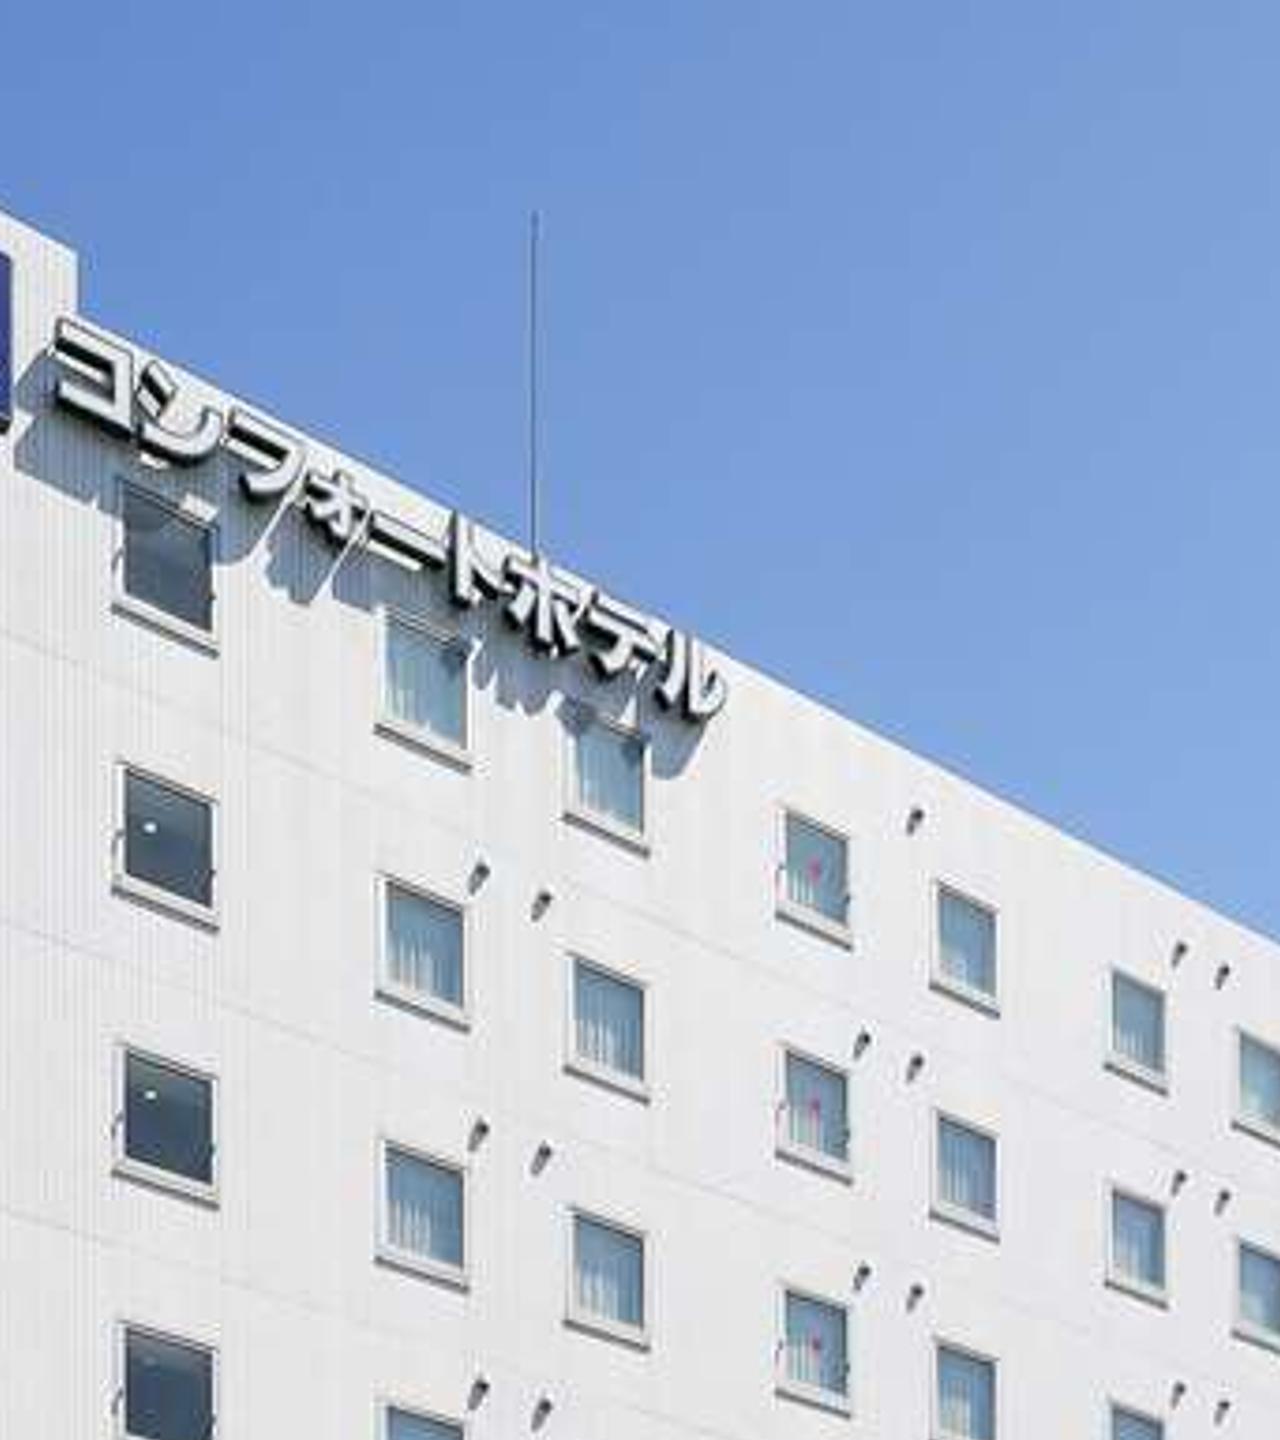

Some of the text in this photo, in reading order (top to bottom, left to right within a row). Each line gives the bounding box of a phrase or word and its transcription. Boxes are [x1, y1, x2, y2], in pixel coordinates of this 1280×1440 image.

[55, 316, 726, 722] コンフォートホテル
